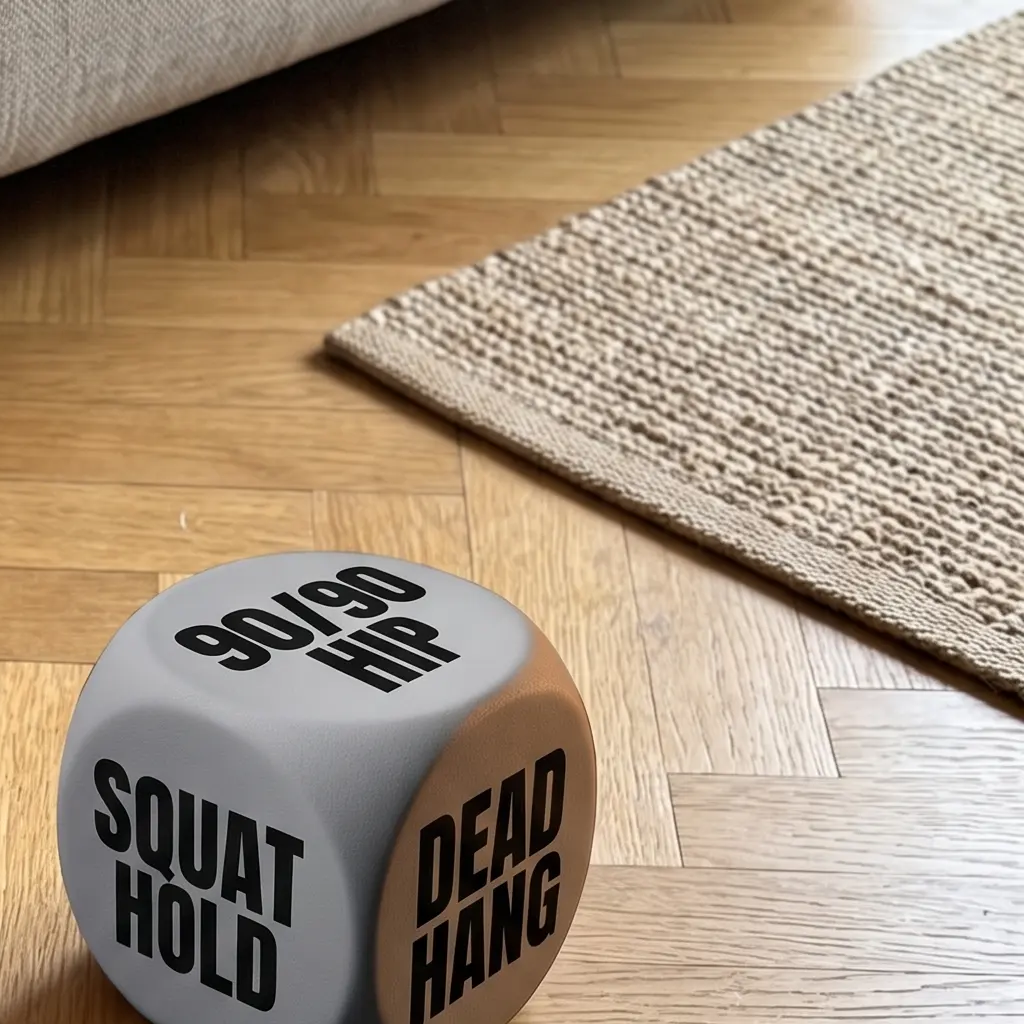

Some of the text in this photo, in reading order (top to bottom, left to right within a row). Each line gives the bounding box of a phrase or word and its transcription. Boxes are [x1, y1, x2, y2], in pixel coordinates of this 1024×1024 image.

[174, 566, 427, 671] 90/90
[305, 616, 461, 693] HIP
[93, 758, 305, 928] SQUAT
[416, 748, 566, 929] DEAD
[115, 860, 277, 1012] HOLD
